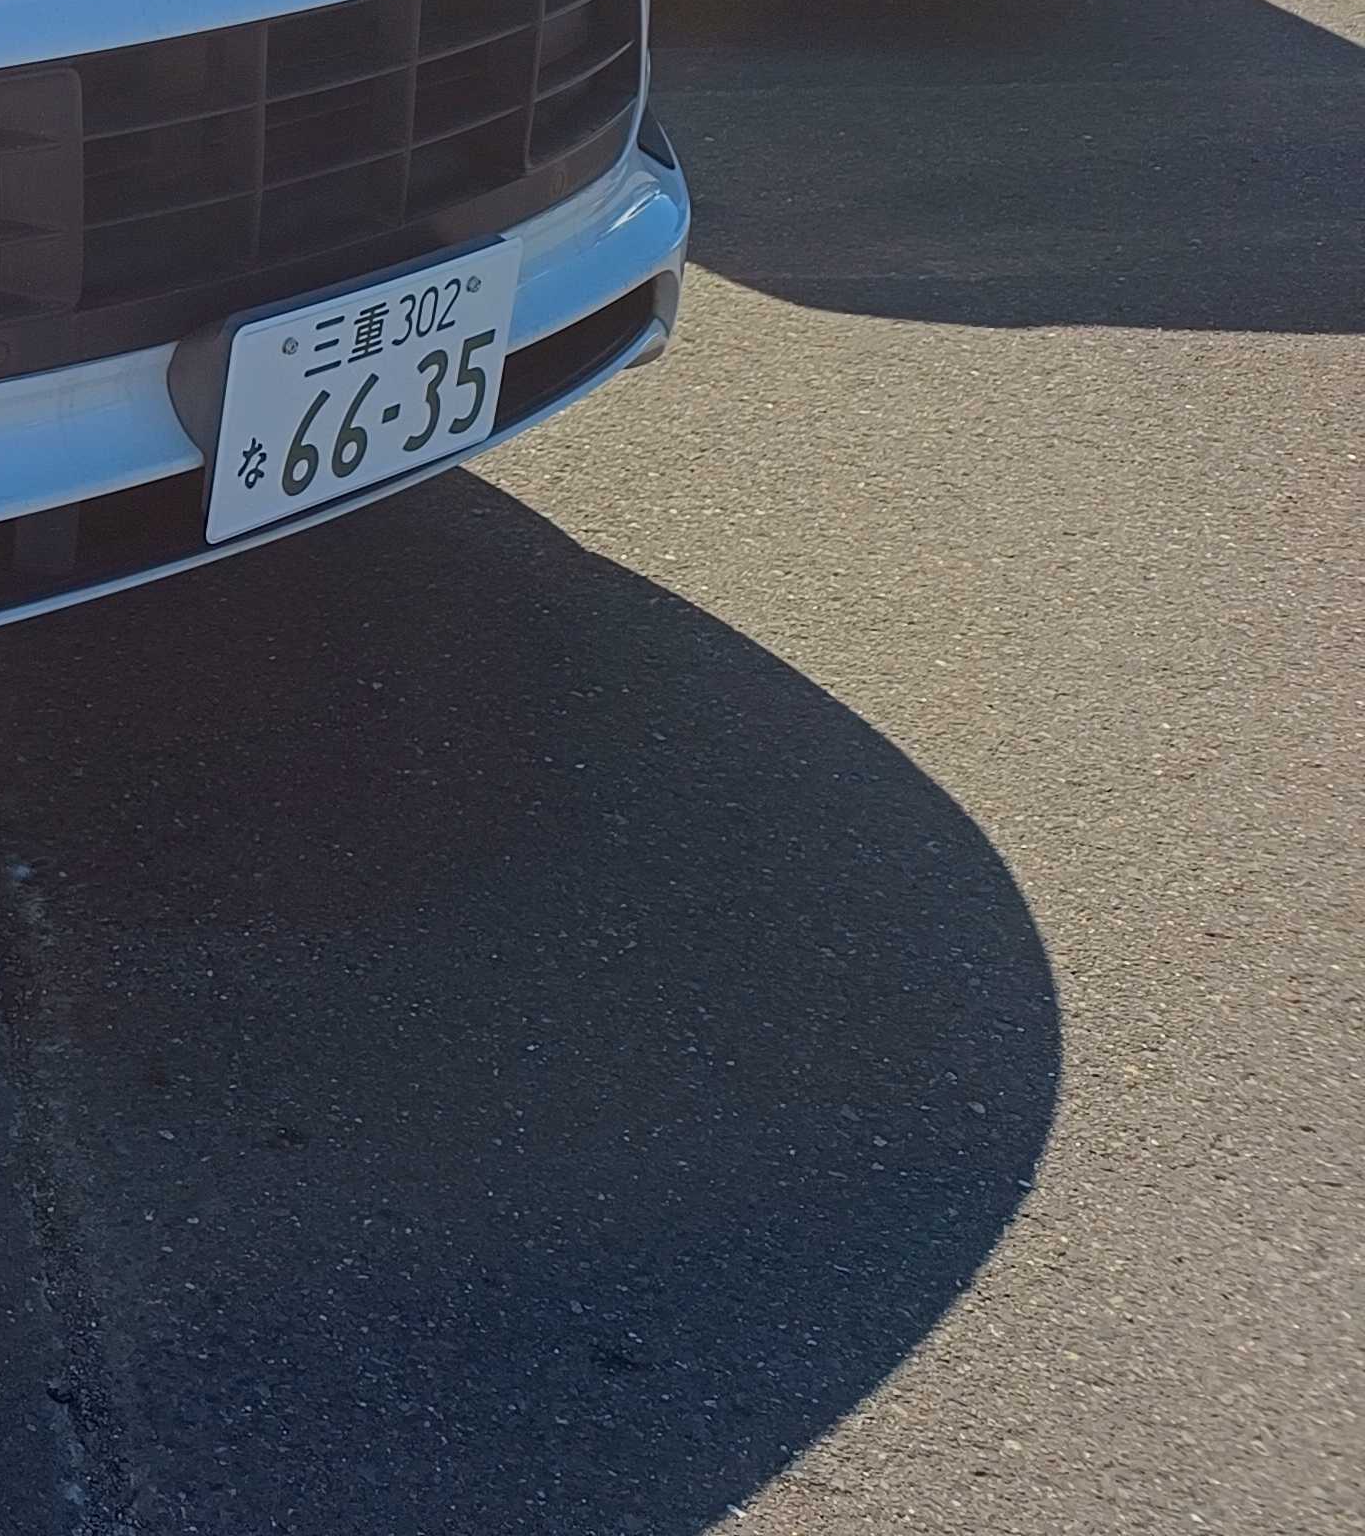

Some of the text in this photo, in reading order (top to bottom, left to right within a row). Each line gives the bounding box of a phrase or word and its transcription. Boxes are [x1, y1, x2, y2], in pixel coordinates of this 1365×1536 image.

[304, 278, 462, 378] 三重 302
[237, 329, 497, 496] な 66-35
